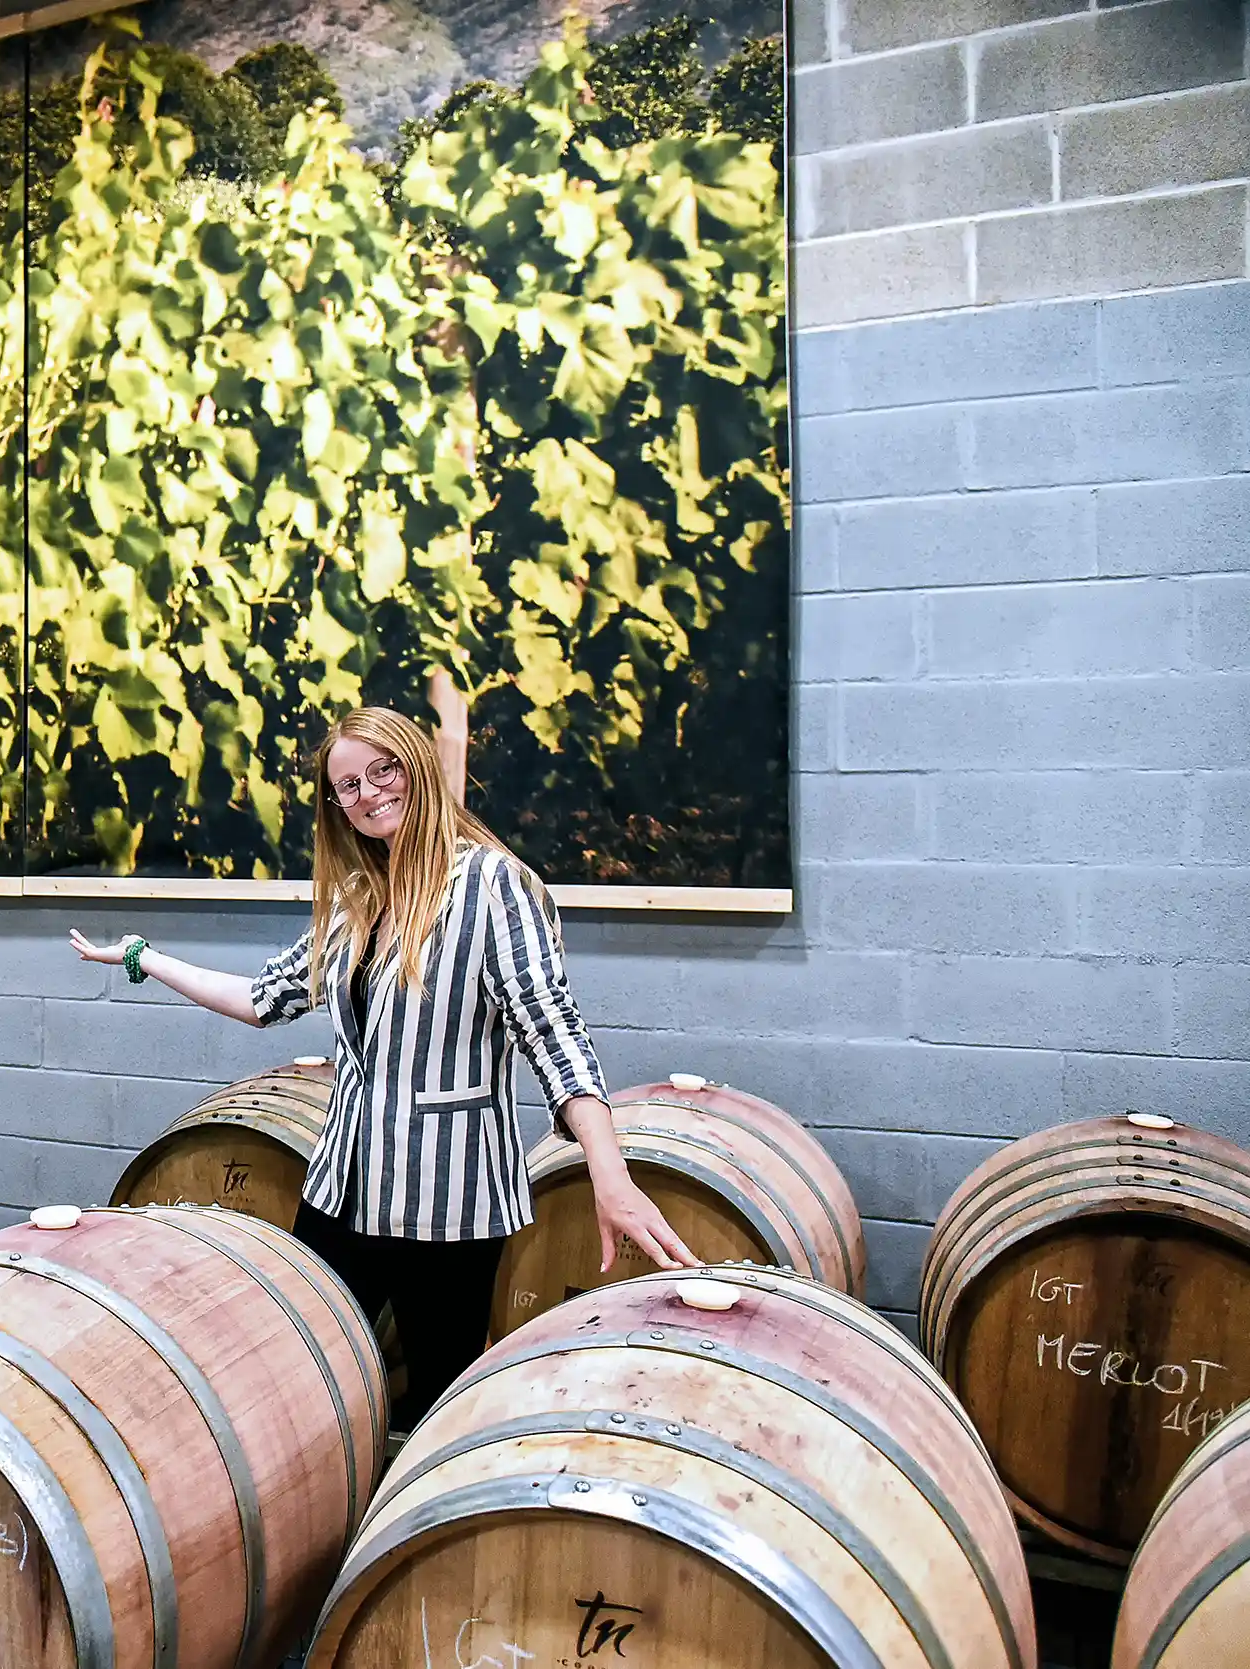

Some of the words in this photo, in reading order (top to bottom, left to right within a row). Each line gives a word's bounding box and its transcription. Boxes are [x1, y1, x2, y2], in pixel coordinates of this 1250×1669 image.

[513, 1289, 539, 1309] IGT
[1029, 1269, 1084, 1305] IGT
[1036, 1332, 1229, 1396] MERLOT
